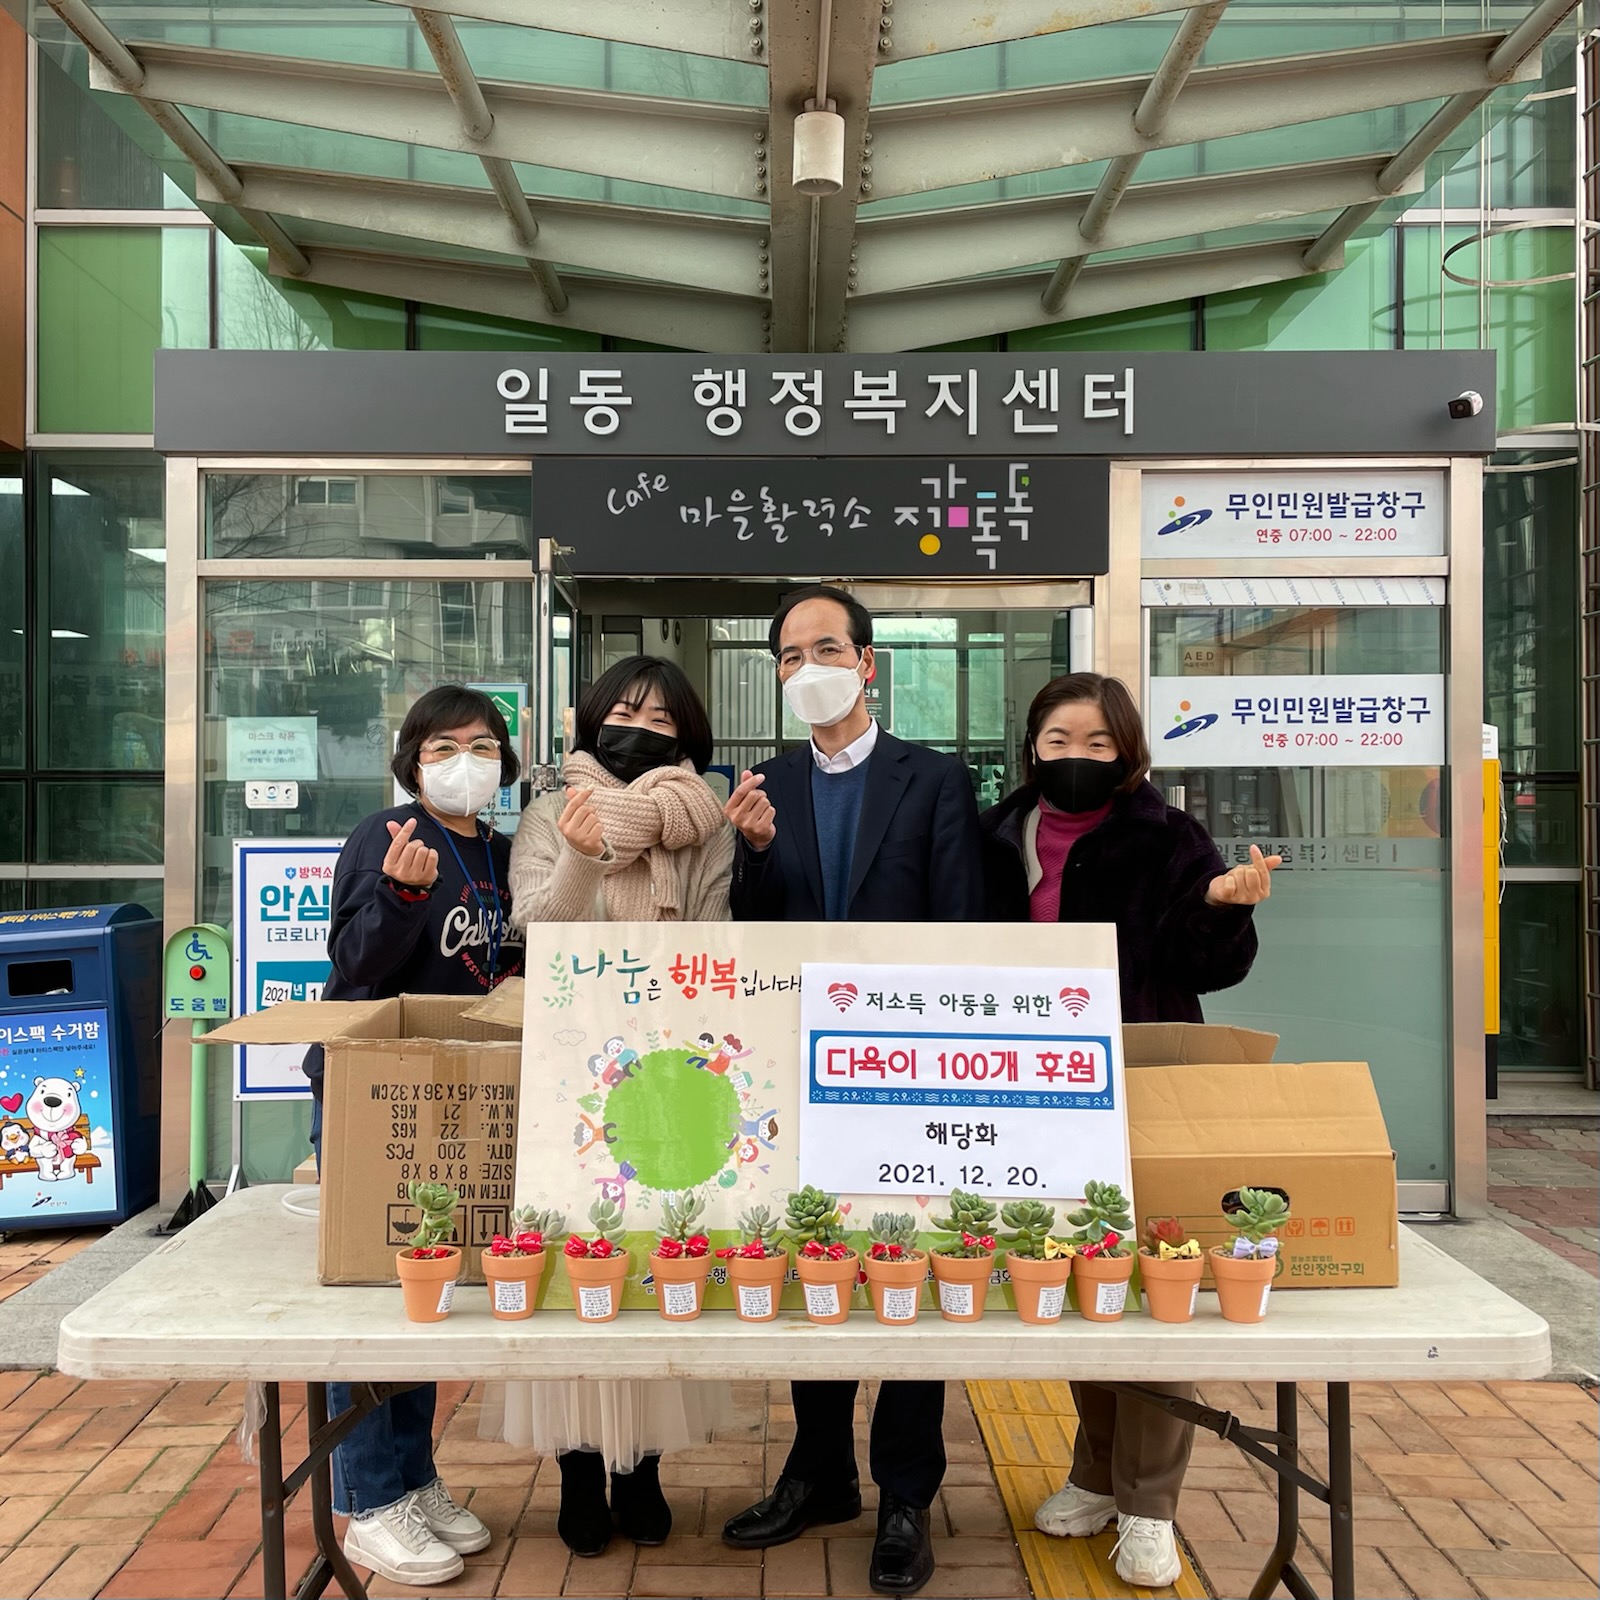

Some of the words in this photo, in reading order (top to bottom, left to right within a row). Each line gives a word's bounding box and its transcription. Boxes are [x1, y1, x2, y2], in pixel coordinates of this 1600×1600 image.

[496, 367, 633, 435] 일동
[691, 367, 1134, 437] 행정복지센터
[606, 471, 670, 515] Cafe
[1225, 491, 1426, 520] 무인민원발급창구
[679, 486, 872, 543] 마을활력소
[1256, 529, 1283, 544] 연중
[1289, 528, 1333, 542] 07:00
[1354, 528, 1397, 541] 22:00
[1184, 652, 1215, 661] AED
[1231, 696, 1431, 724] 무인민원발급창구
[248, 731, 274, 741] 마스크
[1262, 734, 1289, 748] 연중
[1295, 733, 1338, 747] 07:00
[1360, 733, 1403, 746] 22:00
[260, 885, 330, 921] 안심
[571, 949, 662, 1004] 나눔은
[171, 998, 227, 1012] 도움벨
[866, 991, 926, 1015] 저소득
[938, 993, 1000, 1017] 아동을
[1011, 994, 1053, 1017] 위한
[51, 1021, 100, 1041] 수거함
[827, 1046, 917, 1080] 다육이
[937, 1050, 1019, 1083] 100개
[1035, 1050, 1096, 1083] 후원
[412, 1084, 420, 1100] X
[424, 1083, 443, 1100] 36
[447, 1084, 455, 1100] X
[457, 1084, 477, 1101] 45
[480, 1084, 515, 1100] MEAS:
[392, 1104, 417, 1119] KGS
[444, 1104, 461, 1120] 21
[480, 1104, 514, 1119] N.W.:
[392, 1123, 417, 1138] KGS
[440, 1124, 459, 1140] 22
[480, 1123, 513, 1138] G.W.:
[925, 1121, 998, 1150] 해당화
[386, 1143, 415, 1160] PCS
[438, 1143, 466, 1159] 200
[487, 1143, 513, 1160] QTY:
[429, 1164, 438, 1180] 8
[459, 1164, 468, 1180] 8
[479, 1163, 513, 1180] SIZE:
[878, 1163, 945, 1186] 2021.
[959, 1165, 992, 1187] 12.
[1006, 1166, 1047, 1188] 20.
[480, 1184, 511, 1199] ITEM
[1290, 1263, 1364, 1276] 선인장연구회
